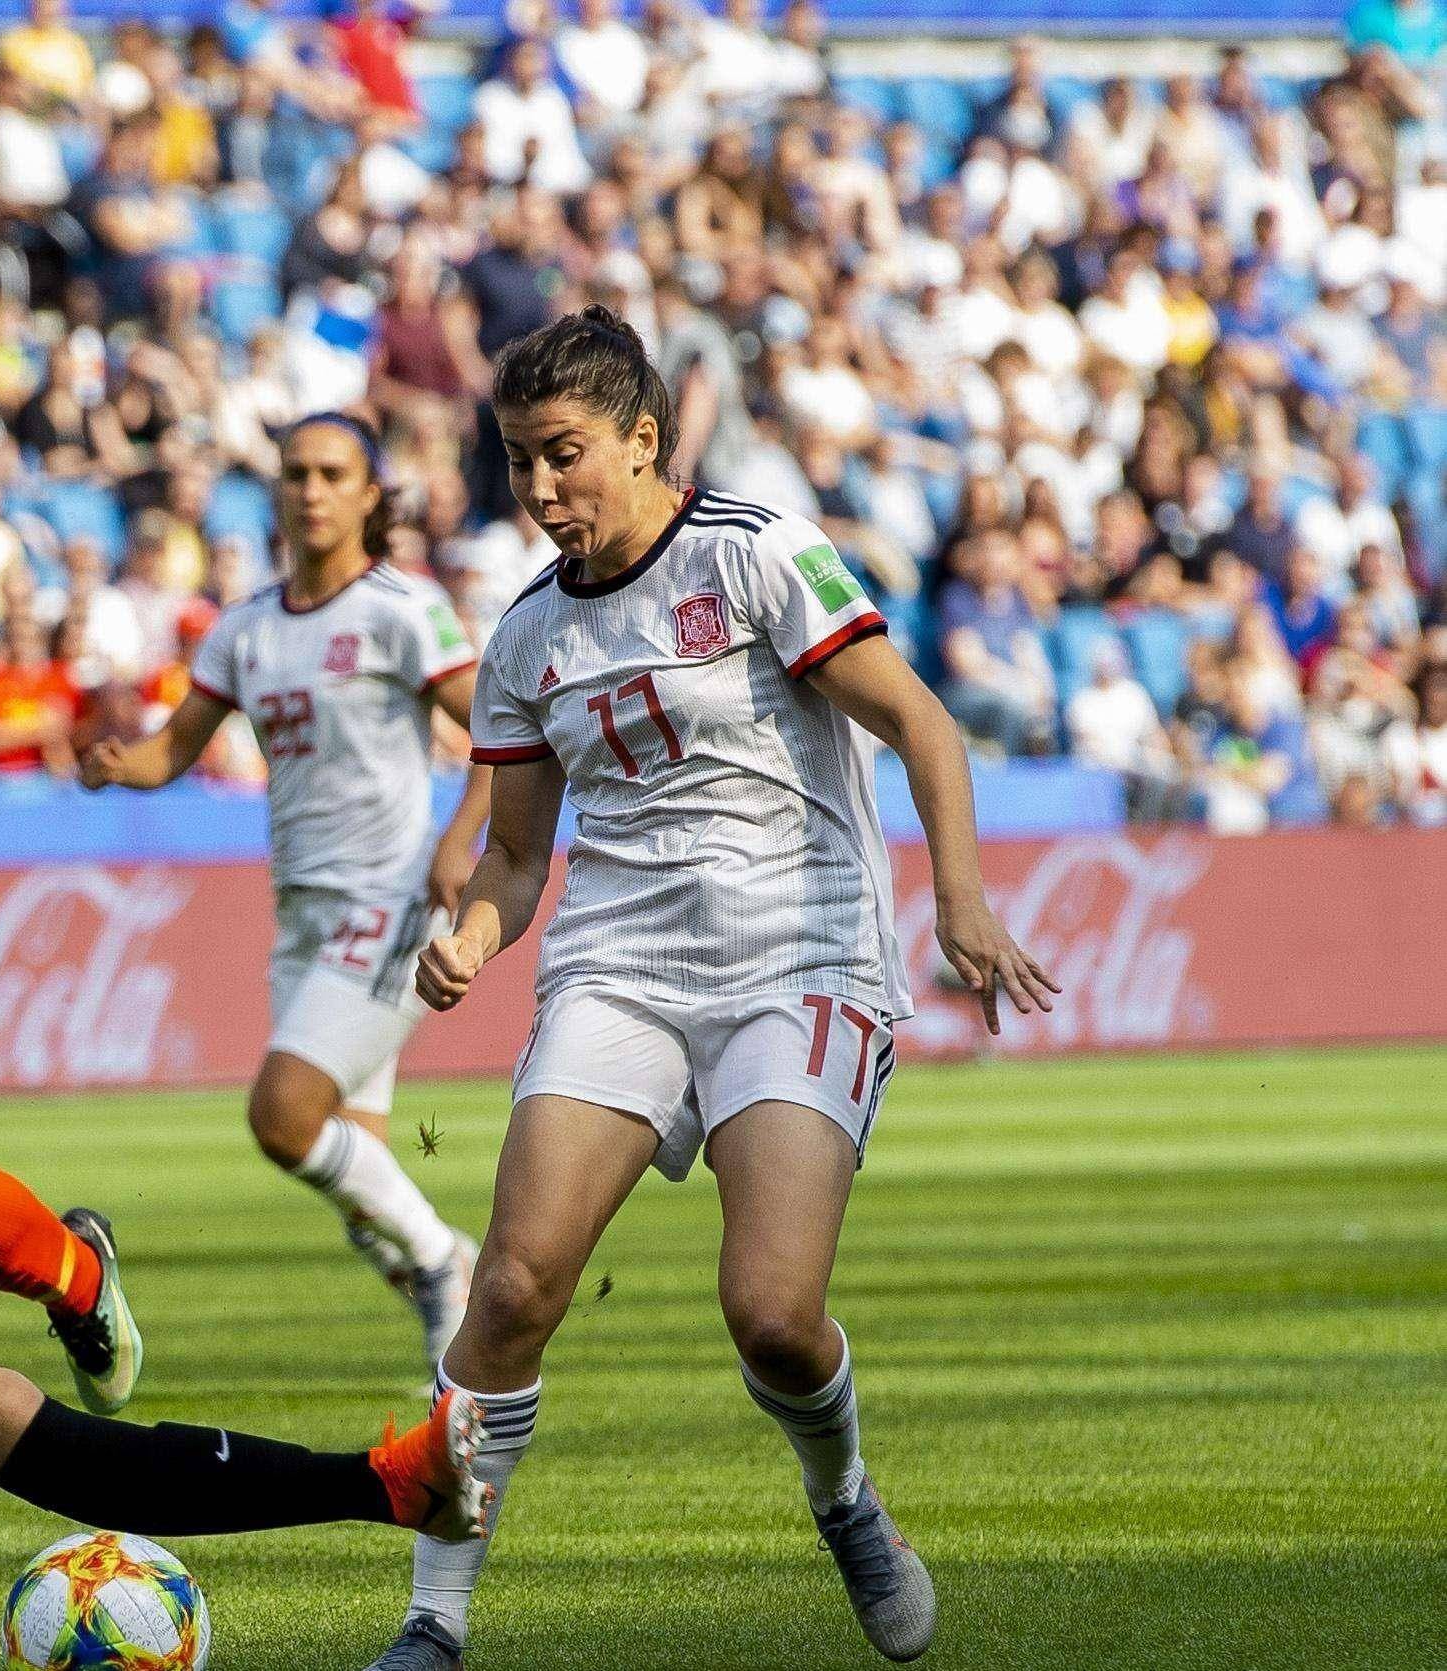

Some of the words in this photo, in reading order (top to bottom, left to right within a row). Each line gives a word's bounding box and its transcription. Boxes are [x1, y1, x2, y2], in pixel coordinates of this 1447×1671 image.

[257, 687, 318, 758] 22
[587, 672, 683, 779] 17
[803, 994, 877, 1105] 17
